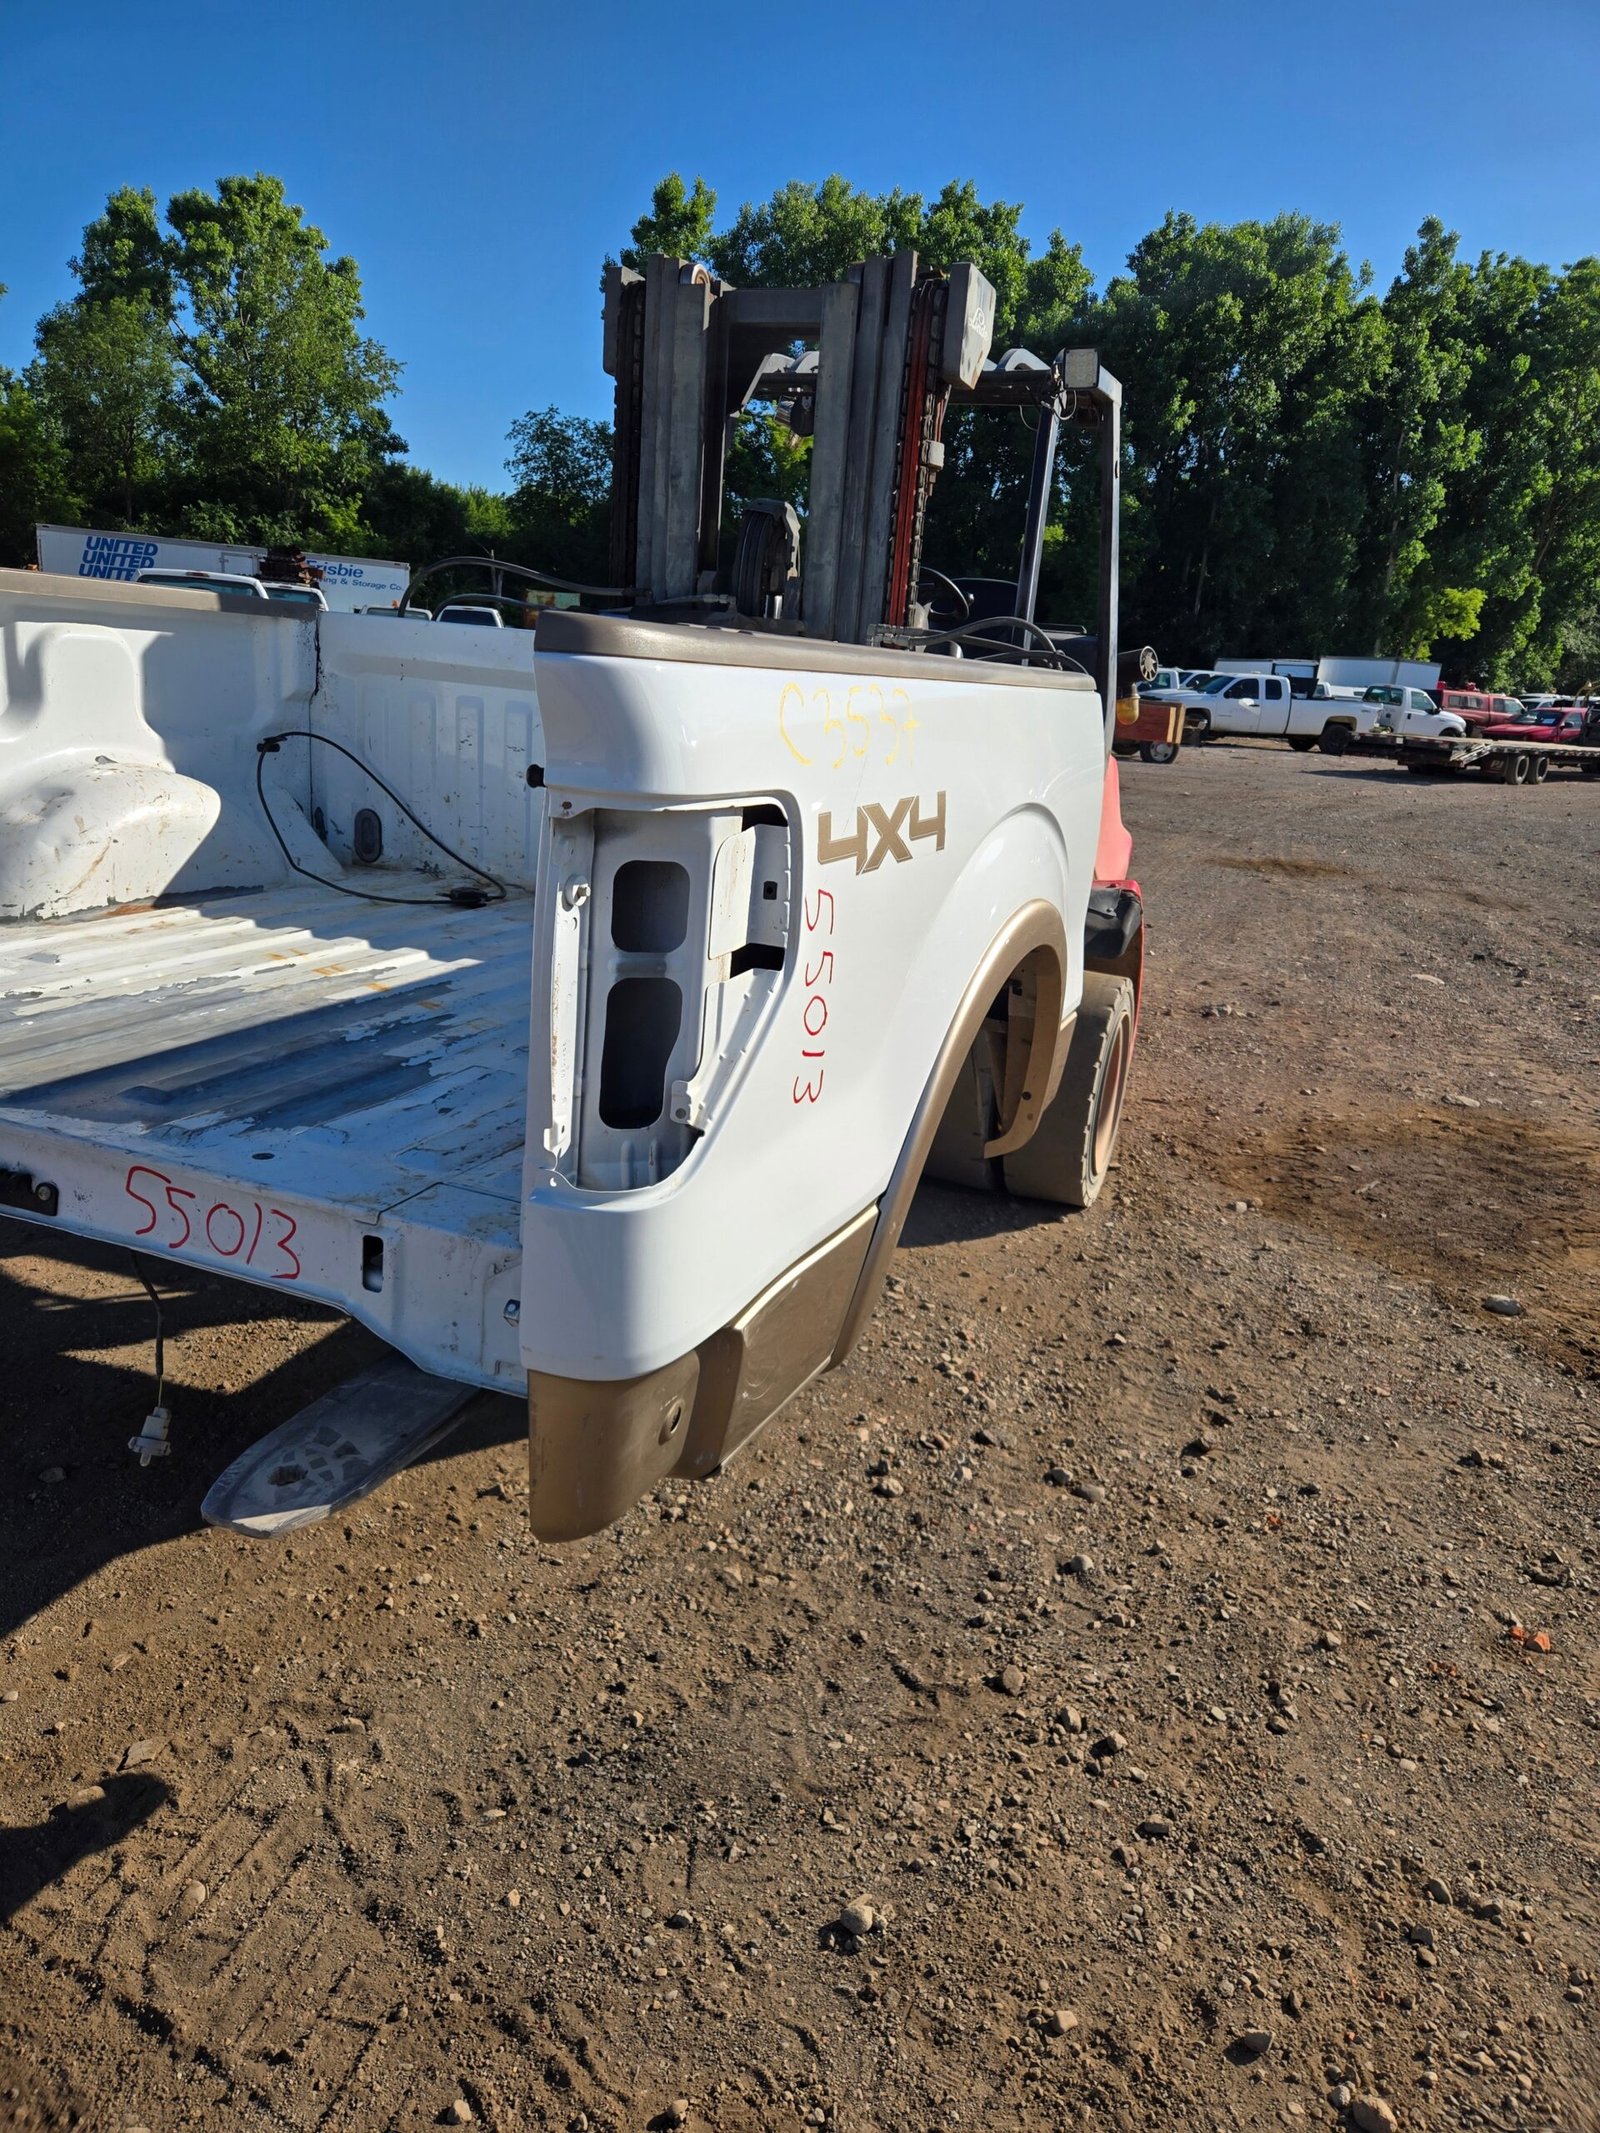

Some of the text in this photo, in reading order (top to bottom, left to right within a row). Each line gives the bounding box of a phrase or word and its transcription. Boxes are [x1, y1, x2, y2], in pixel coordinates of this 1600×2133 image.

[86, 536, 158, 556] UNITED
[82, 550, 155, 569] UNITED
[79, 563, 138, 581] UNITE
[352, 579, 387, 590] Storage
[793, 889, 834, 1105] 55013
[126, 1166, 300, 1280] 55013
